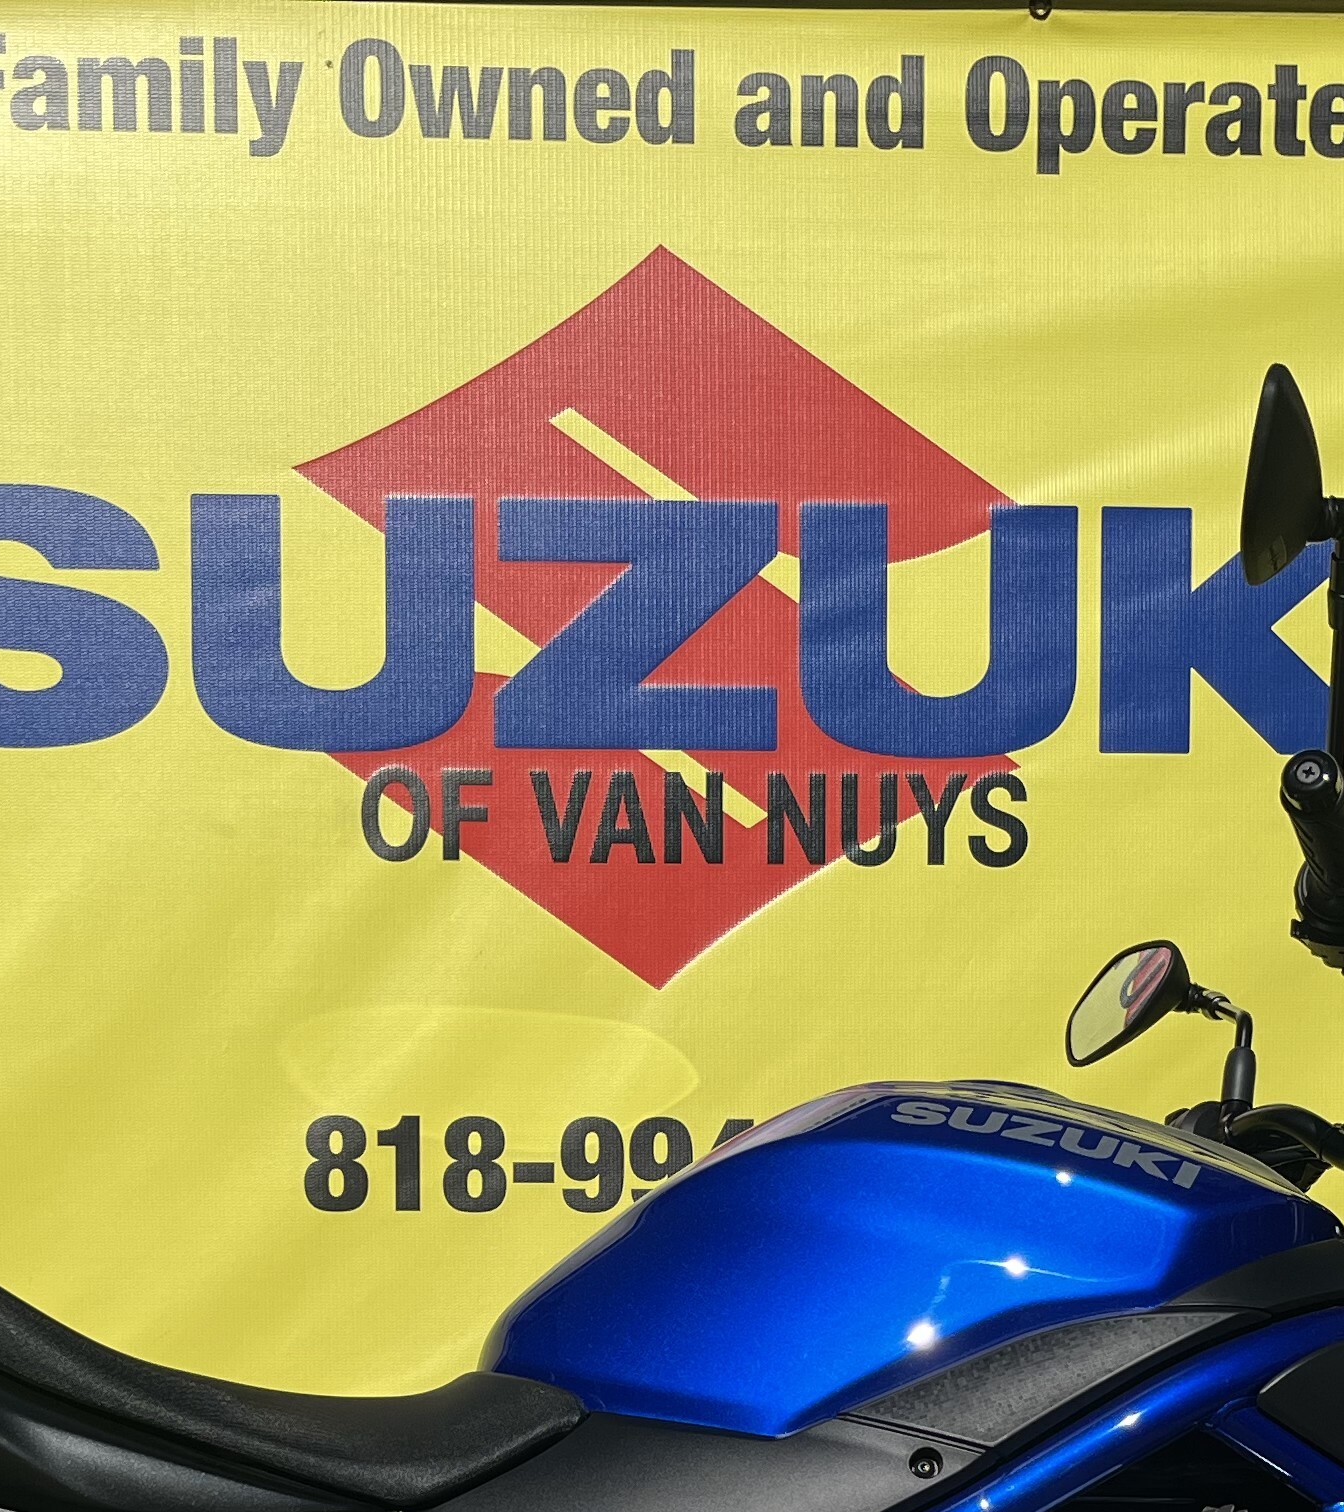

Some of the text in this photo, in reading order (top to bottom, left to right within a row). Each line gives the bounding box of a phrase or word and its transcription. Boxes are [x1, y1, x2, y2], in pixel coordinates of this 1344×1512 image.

[339, 37, 696, 145] Owned
[734, 54, 925, 150] and
[359, 763, 1030, 868] OF VAN NUYS
[303, 1114, 755, 1214] 818-99
[889, 1100, 1202, 1190] SUZUKI
